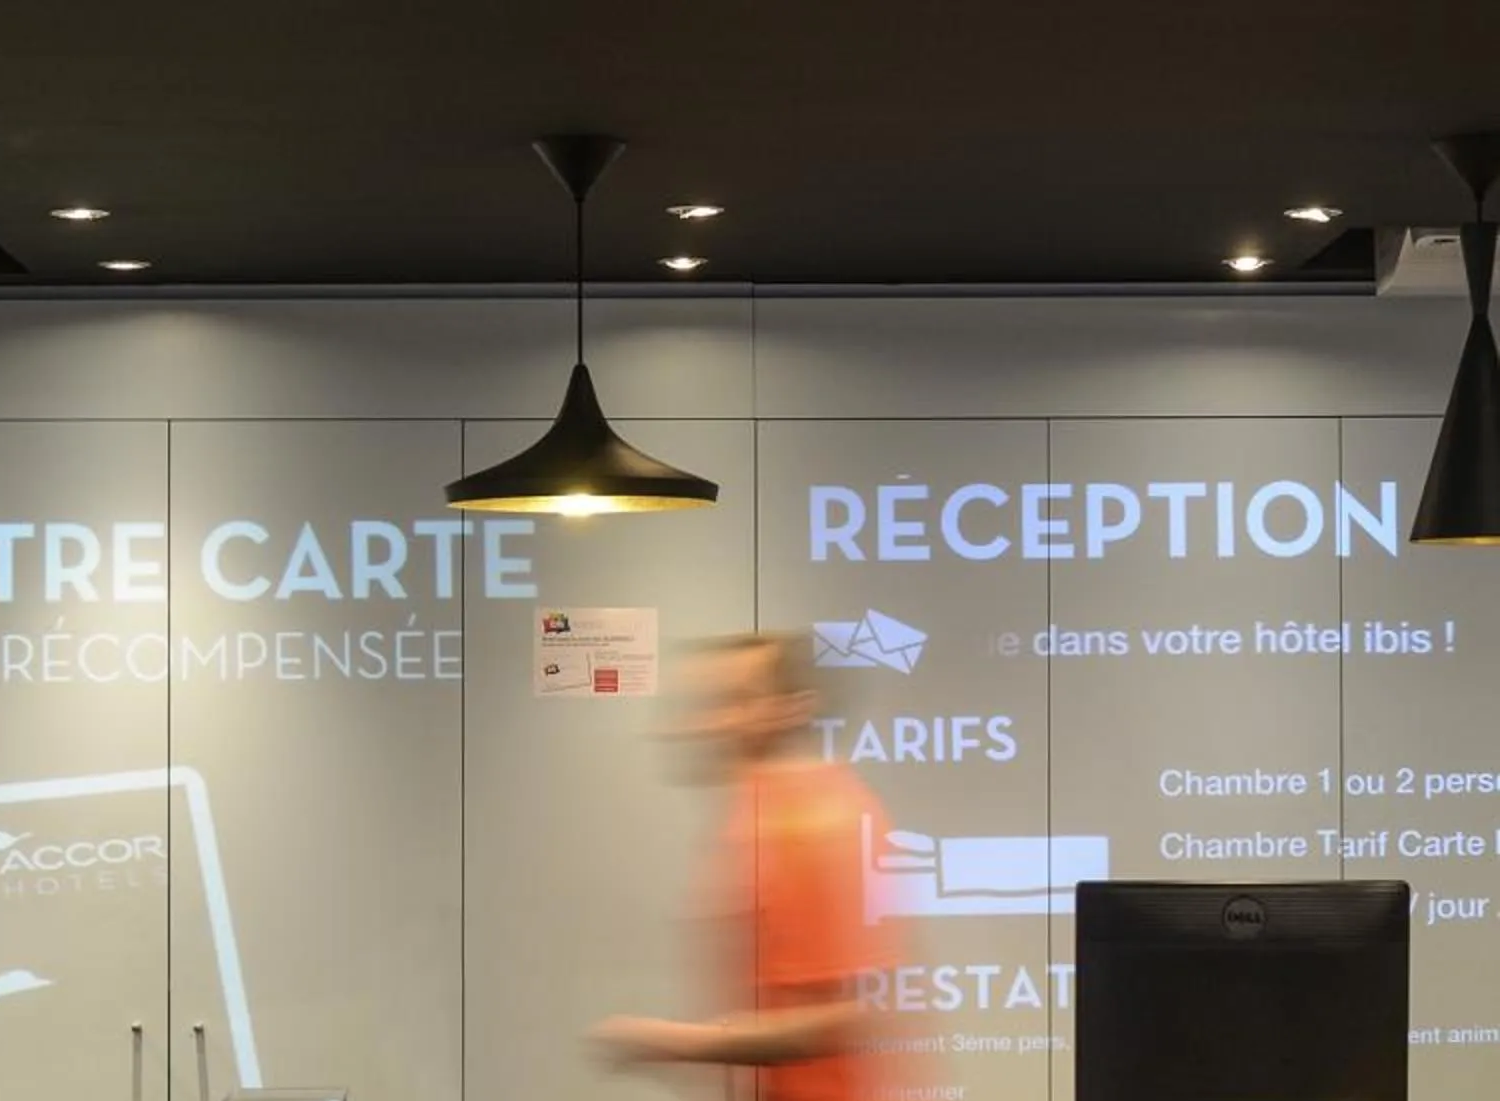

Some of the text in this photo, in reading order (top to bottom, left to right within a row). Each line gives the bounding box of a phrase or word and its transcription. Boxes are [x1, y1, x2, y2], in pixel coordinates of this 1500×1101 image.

[809, 474, 1398, 562] RÉCEPTION
[201, 520, 539, 601] CARTE
[3, 614, 464, 681] RÉCOMPENSÉE
[1033, 624, 1129, 656] dans
[1142, 628, 1242, 655] votre
[1255, 621, 1350, 654] hôtel
[1363, 620, 1432, 653] ibis
[1446, 621, 1455, 652] !
[812, 715, 1017, 763] TARIFS
[1160, 768, 1500, 799] Chambre 1 ou 2 pers
[0, 835, 167, 874] ACCOR
[1160, 831, 1307, 860] Chambre
[1317, 829, 1388, 858] Tarif
[1398, 830, 1486, 857] Carte
[1427, 892, 1489, 924] jour
[850, 963, 1077, 1012] RESTAT
